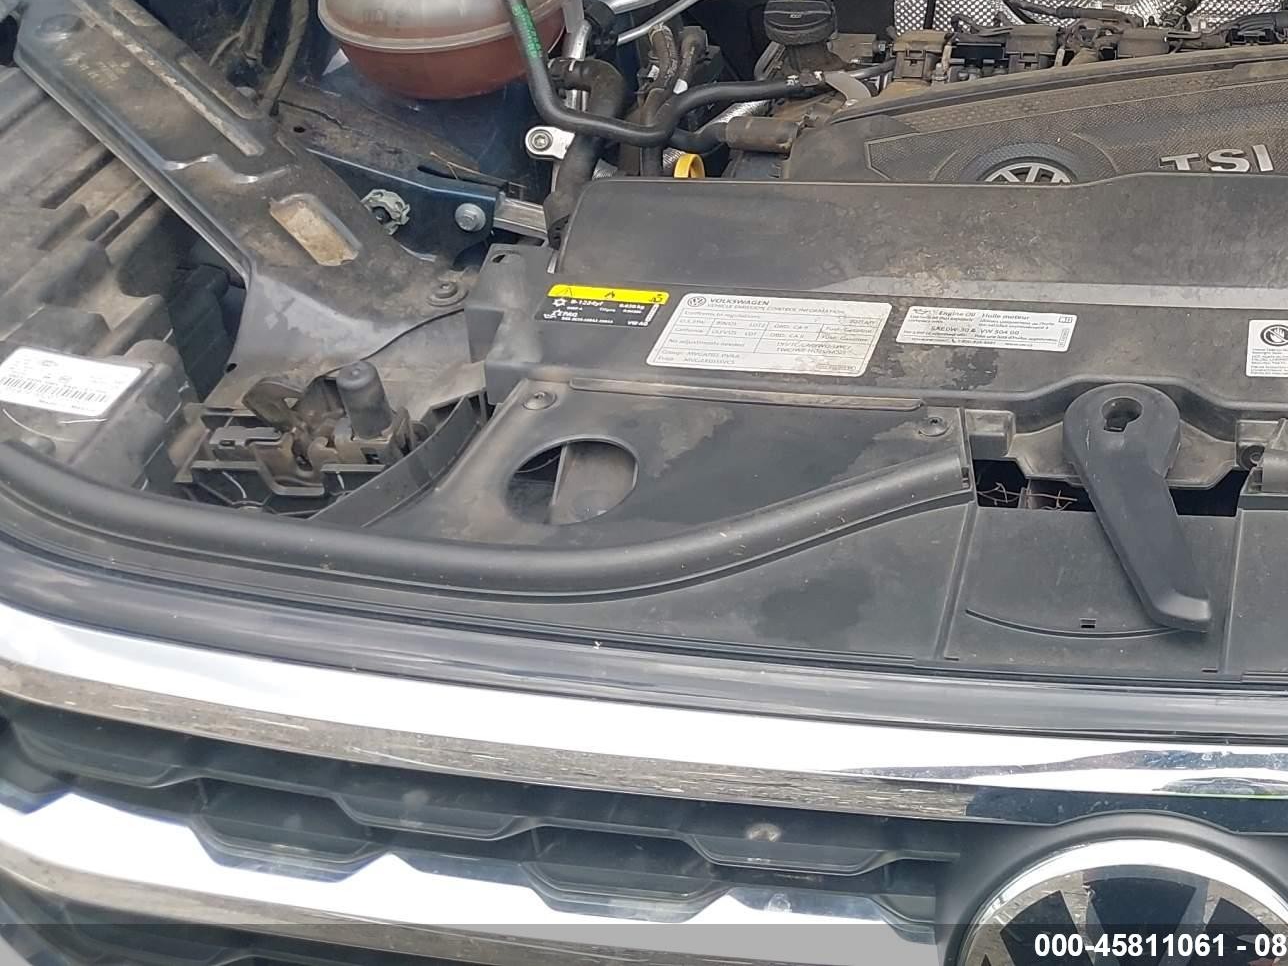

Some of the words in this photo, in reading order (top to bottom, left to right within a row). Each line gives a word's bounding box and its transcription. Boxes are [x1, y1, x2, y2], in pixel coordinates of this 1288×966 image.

[1159, 144, 1274, 172] TSI
[709, 297, 770, 306] VOLKSWAGEN
[938, 310, 963, 318] Engine
